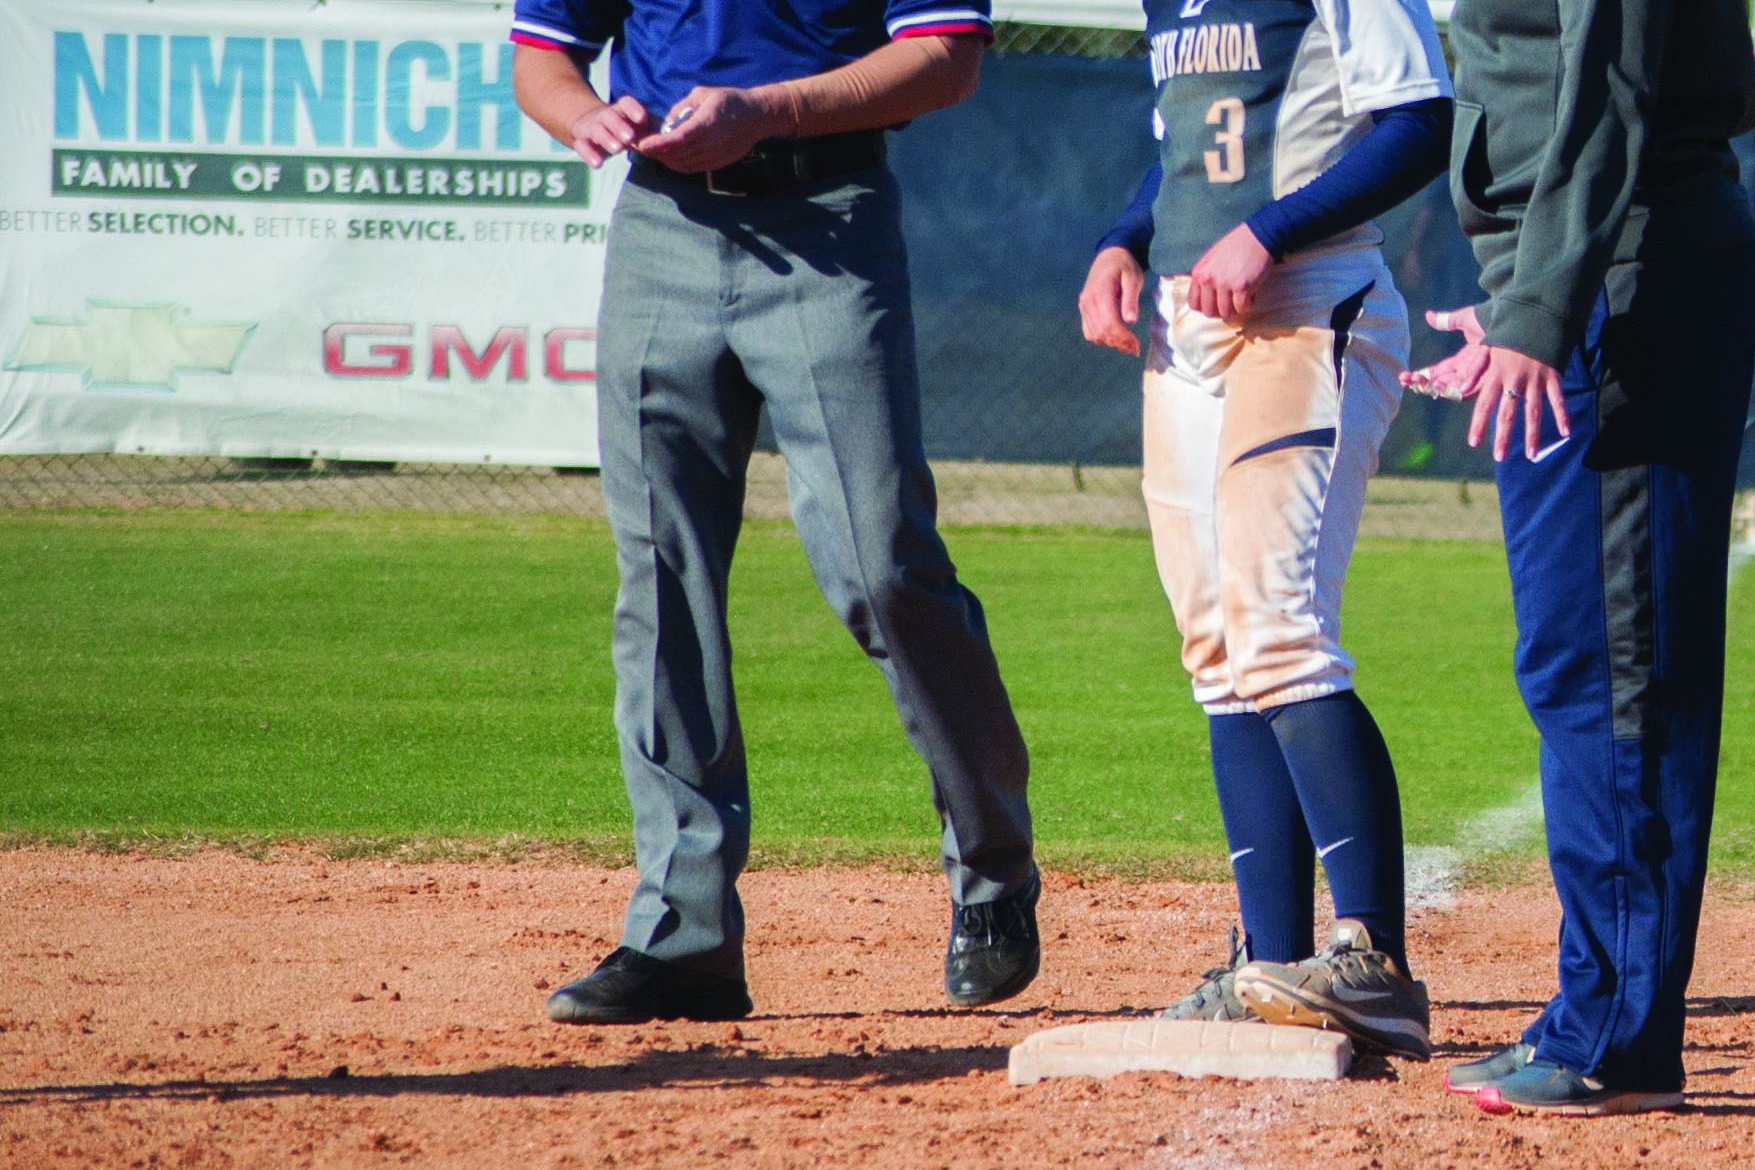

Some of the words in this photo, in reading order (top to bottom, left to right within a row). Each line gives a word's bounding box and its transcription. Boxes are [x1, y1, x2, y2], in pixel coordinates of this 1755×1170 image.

[1176, 21, 1261, 74] FLORIDA
[54, 31, 575, 151] NIMNICH
[1204, 97, 1246, 183] 3
[62, 158, 197, 189] FAMILY
[231, 162, 282, 192] OF
[304, 164, 568, 197] DEALERSHIPS
[0, 210, 81, 232] BETTER
[88, 212, 245, 236] SELECTION.
[255, 217, 338, 239] BETTER
[347, 219, 467, 242] SERVICE.
[474, 221, 557, 243] BETTER
[564, 223, 608, 245] PRI
[323, 323, 598, 381] GMC
